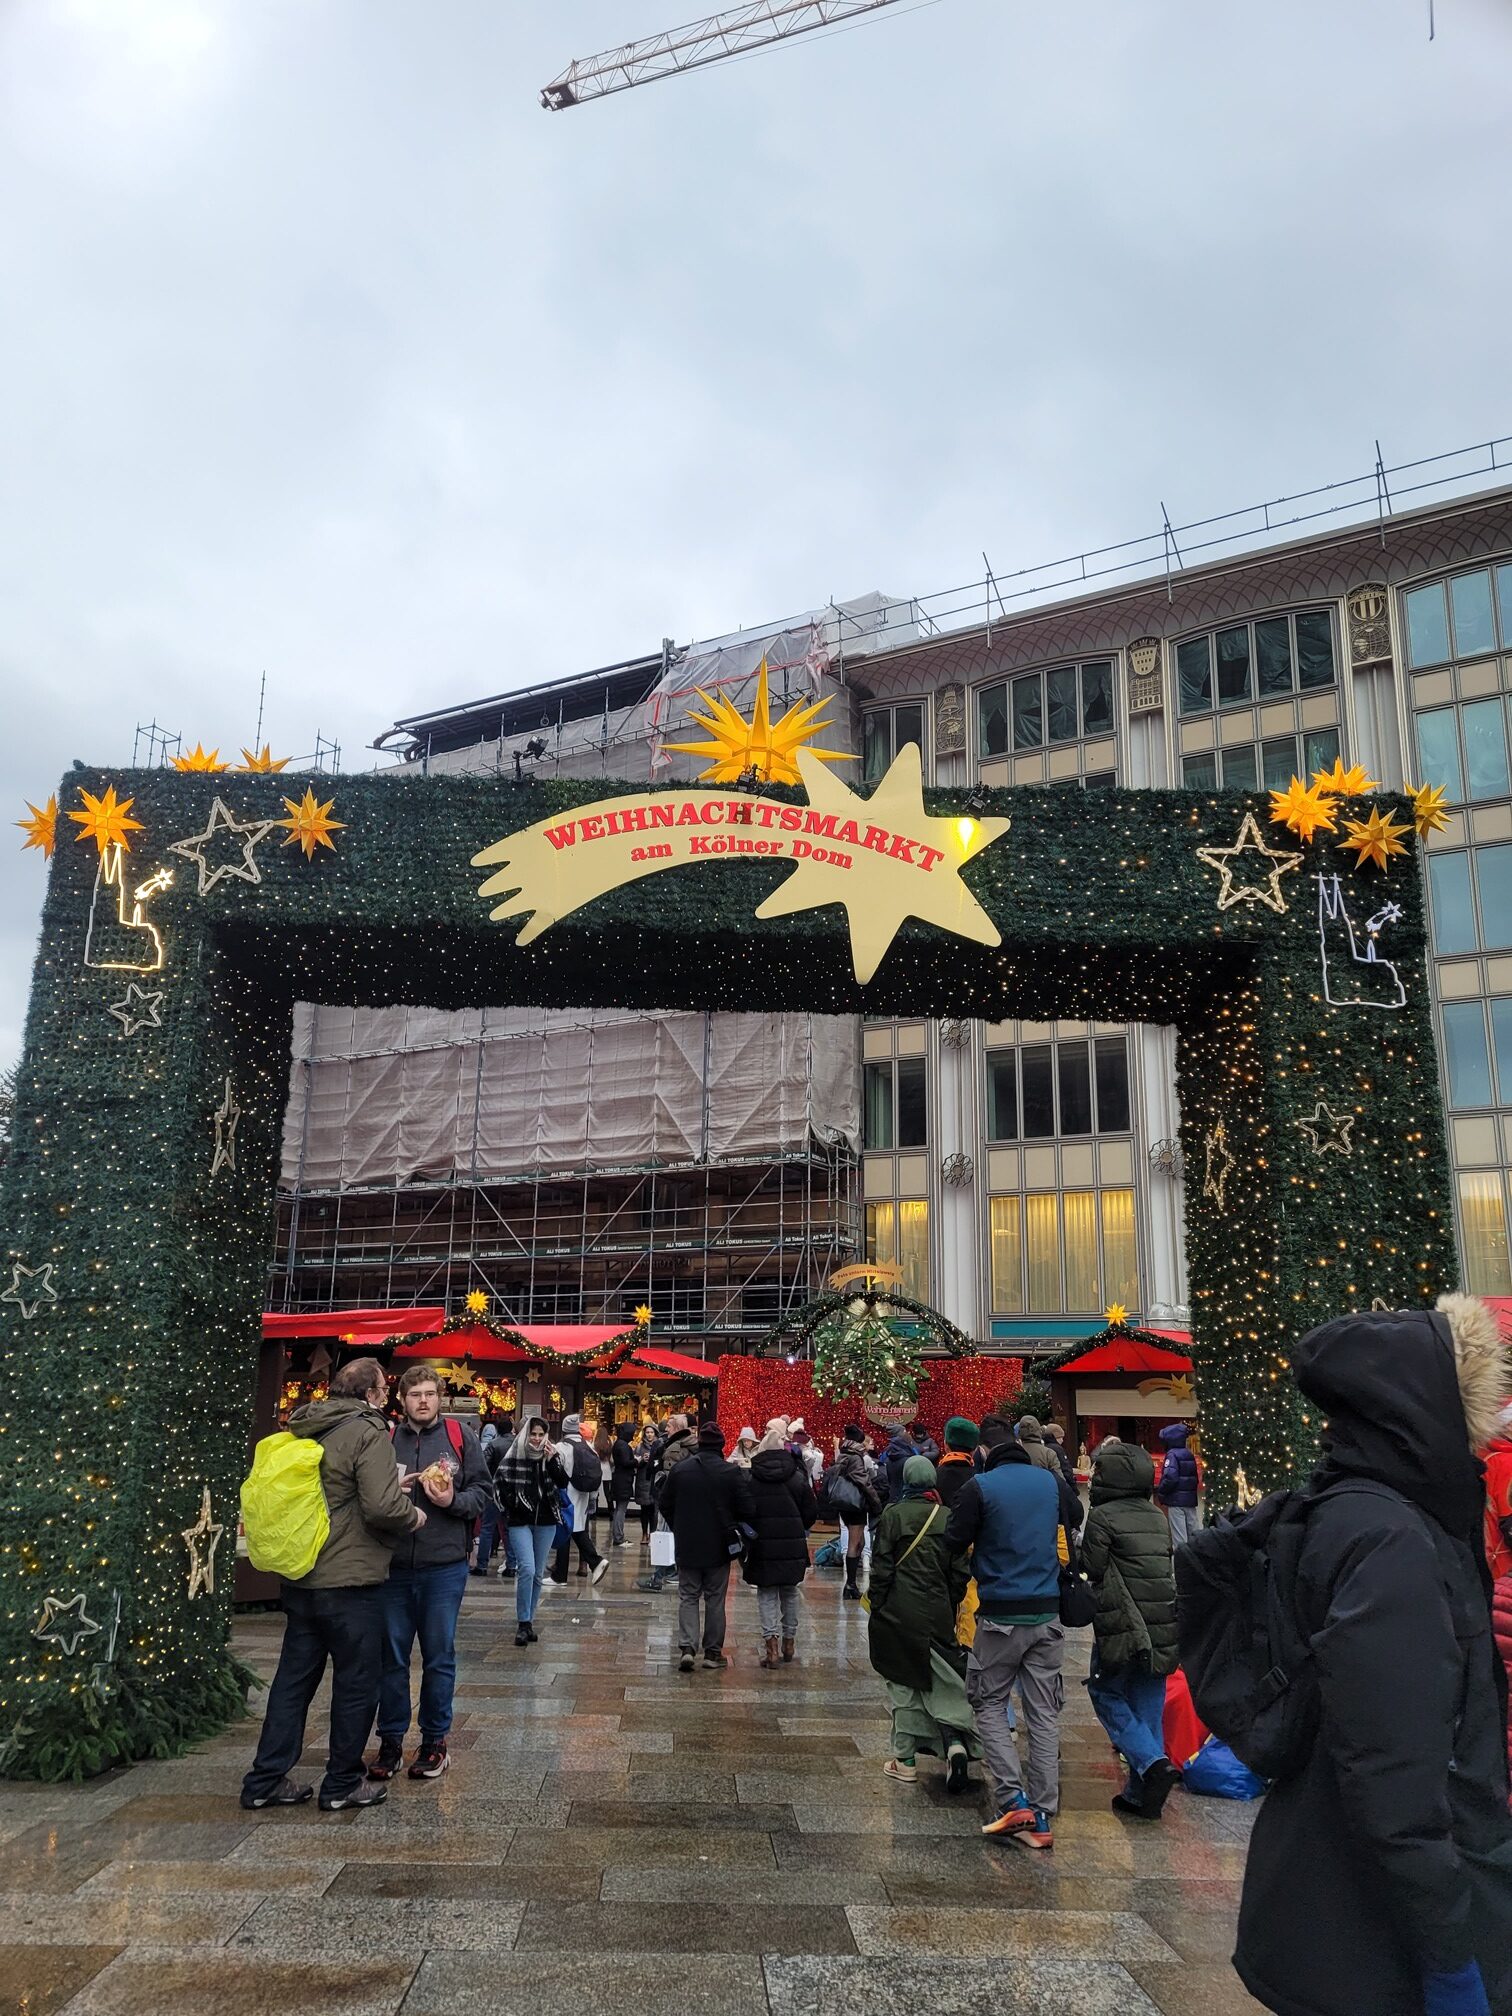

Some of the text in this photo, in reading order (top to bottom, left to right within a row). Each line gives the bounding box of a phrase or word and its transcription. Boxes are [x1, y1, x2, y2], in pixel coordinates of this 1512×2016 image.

[543, 801, 945, 872] WEIHNACHTSMARKT
[631, 834, 853, 869] am Kölner Dom
